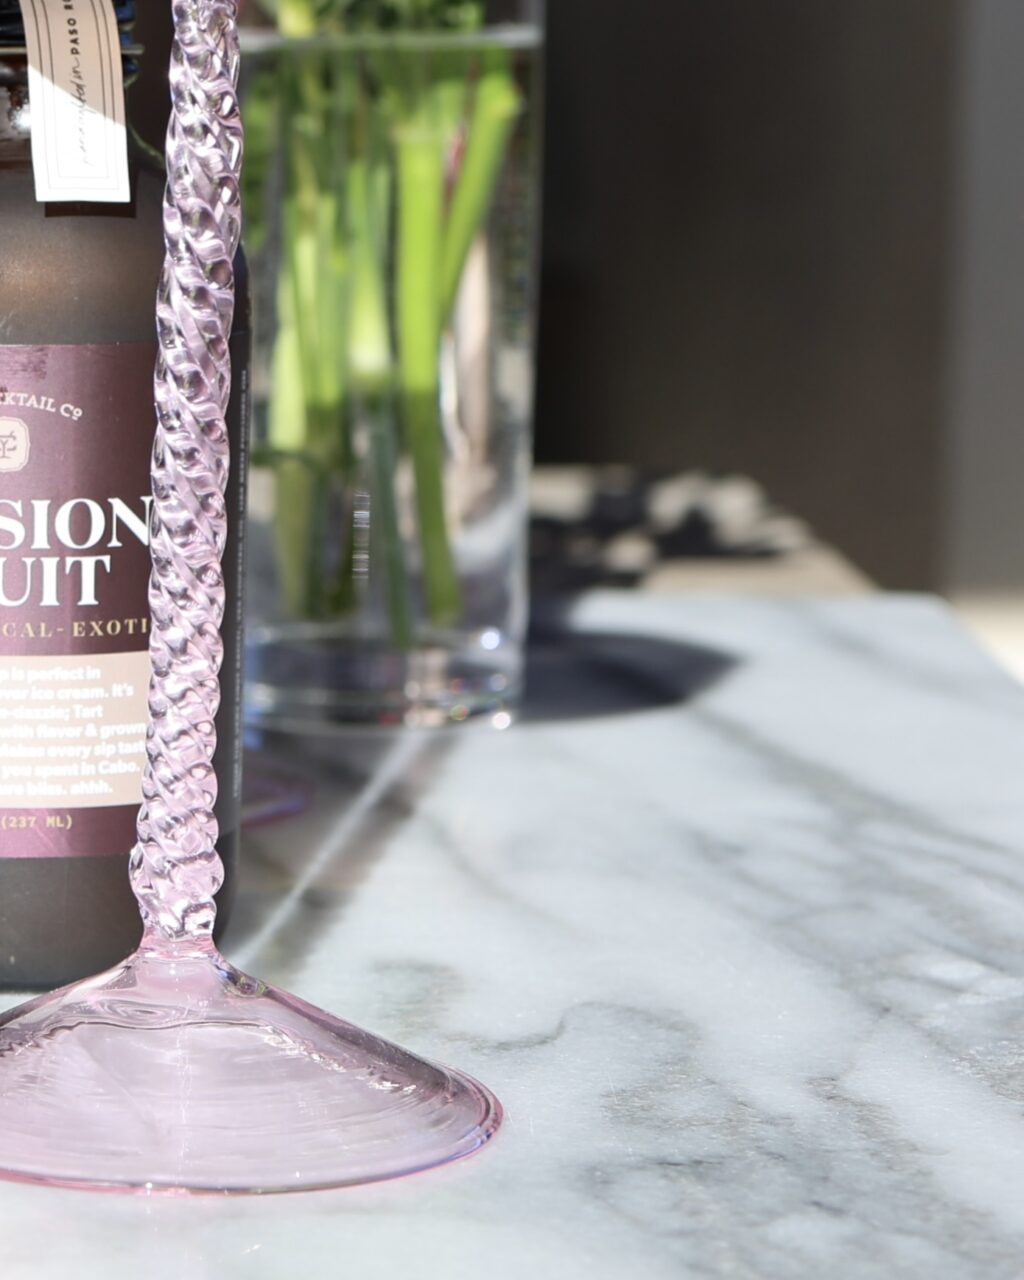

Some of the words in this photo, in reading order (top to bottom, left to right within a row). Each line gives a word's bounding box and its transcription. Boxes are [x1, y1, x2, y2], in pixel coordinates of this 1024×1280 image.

[66, 17, 80, 55] PASO
[86, 665, 101, 680] in
[97, 760, 140, 774] Cabo.
[1, 813, 37, 830] (237
[46, 814, 73, 830] ML)
